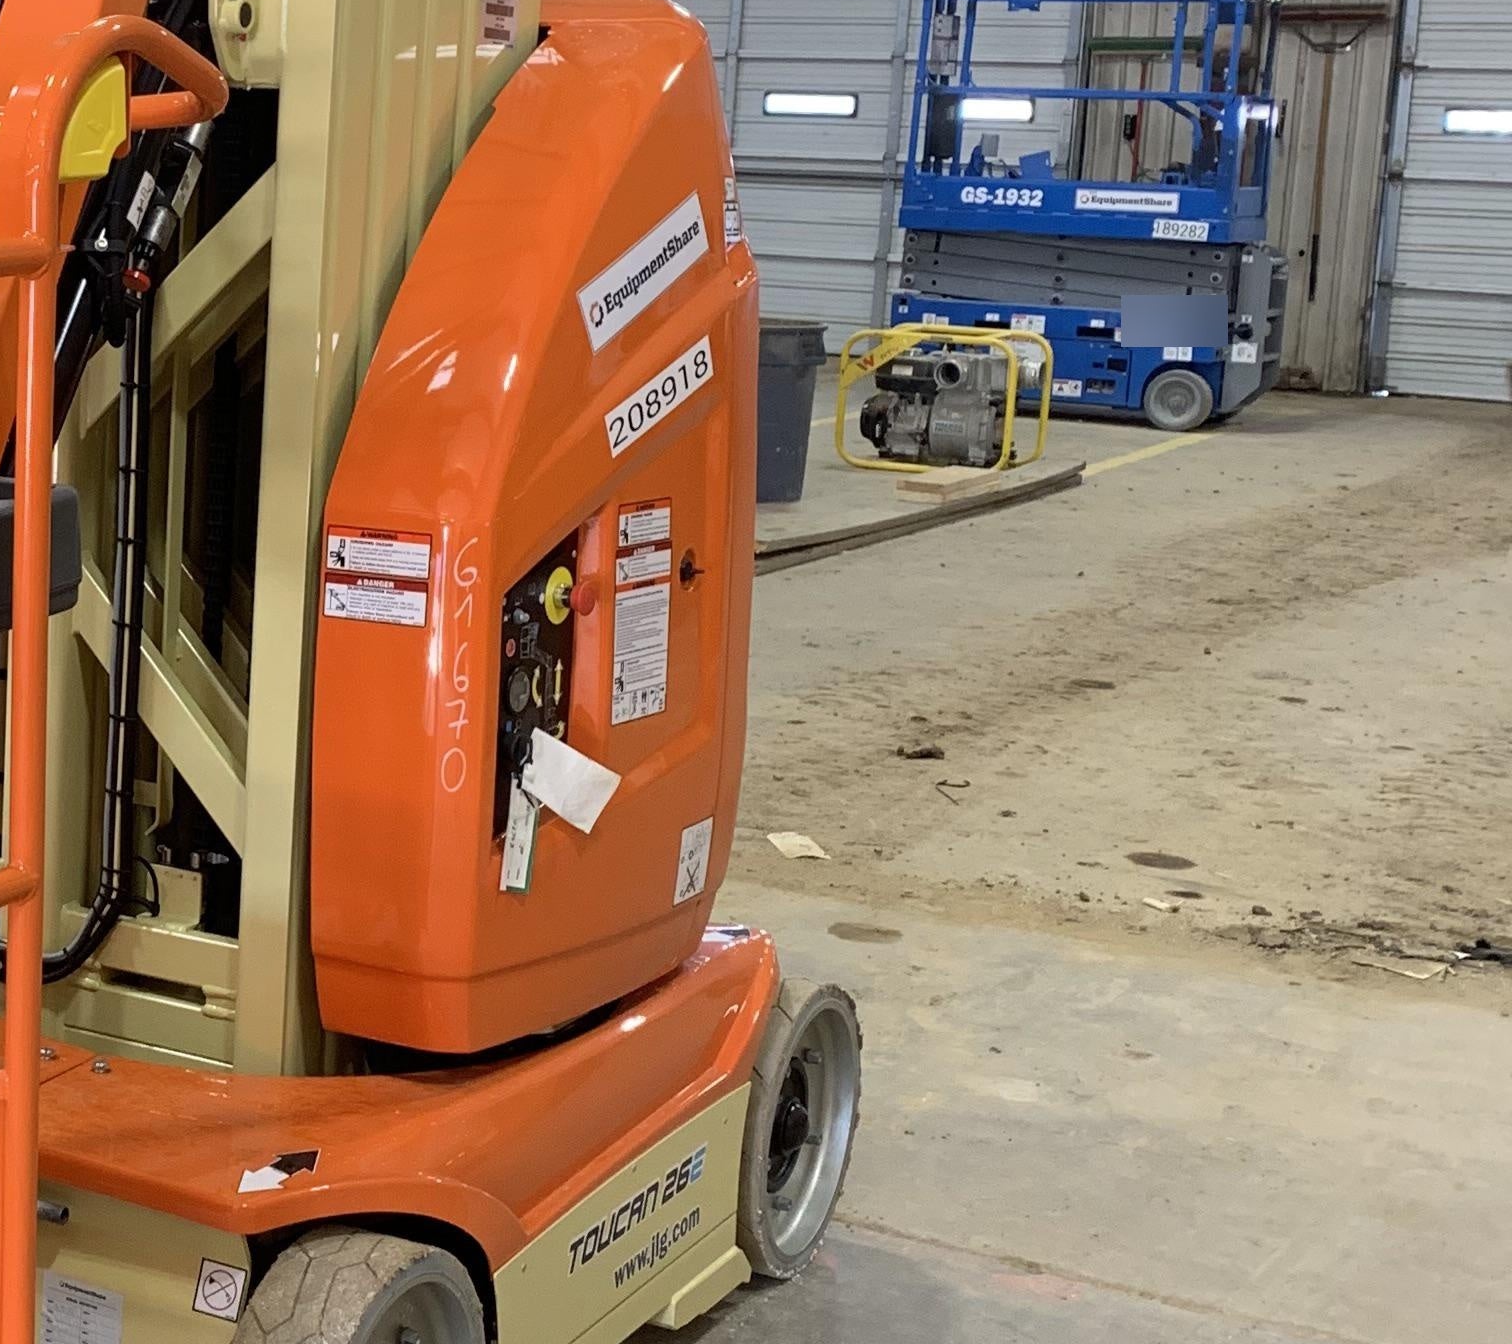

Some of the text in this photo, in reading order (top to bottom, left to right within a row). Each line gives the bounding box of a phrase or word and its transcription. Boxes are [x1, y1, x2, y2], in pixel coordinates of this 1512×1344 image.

[960, 186, 1044, 208] GS-1932
[1090, 194, 1173, 208] EquipmentShare
[1154, 221, 1206, 239] 189282
[603, 220, 700, 315] EquipmentShare
[608, 350, 709, 449] 208918
[363, 579, 395, 589] DANGER
[569, 1146, 707, 1275] TOUCAN 26E
[614, 1207, 700, 1289] www.jlg.com
